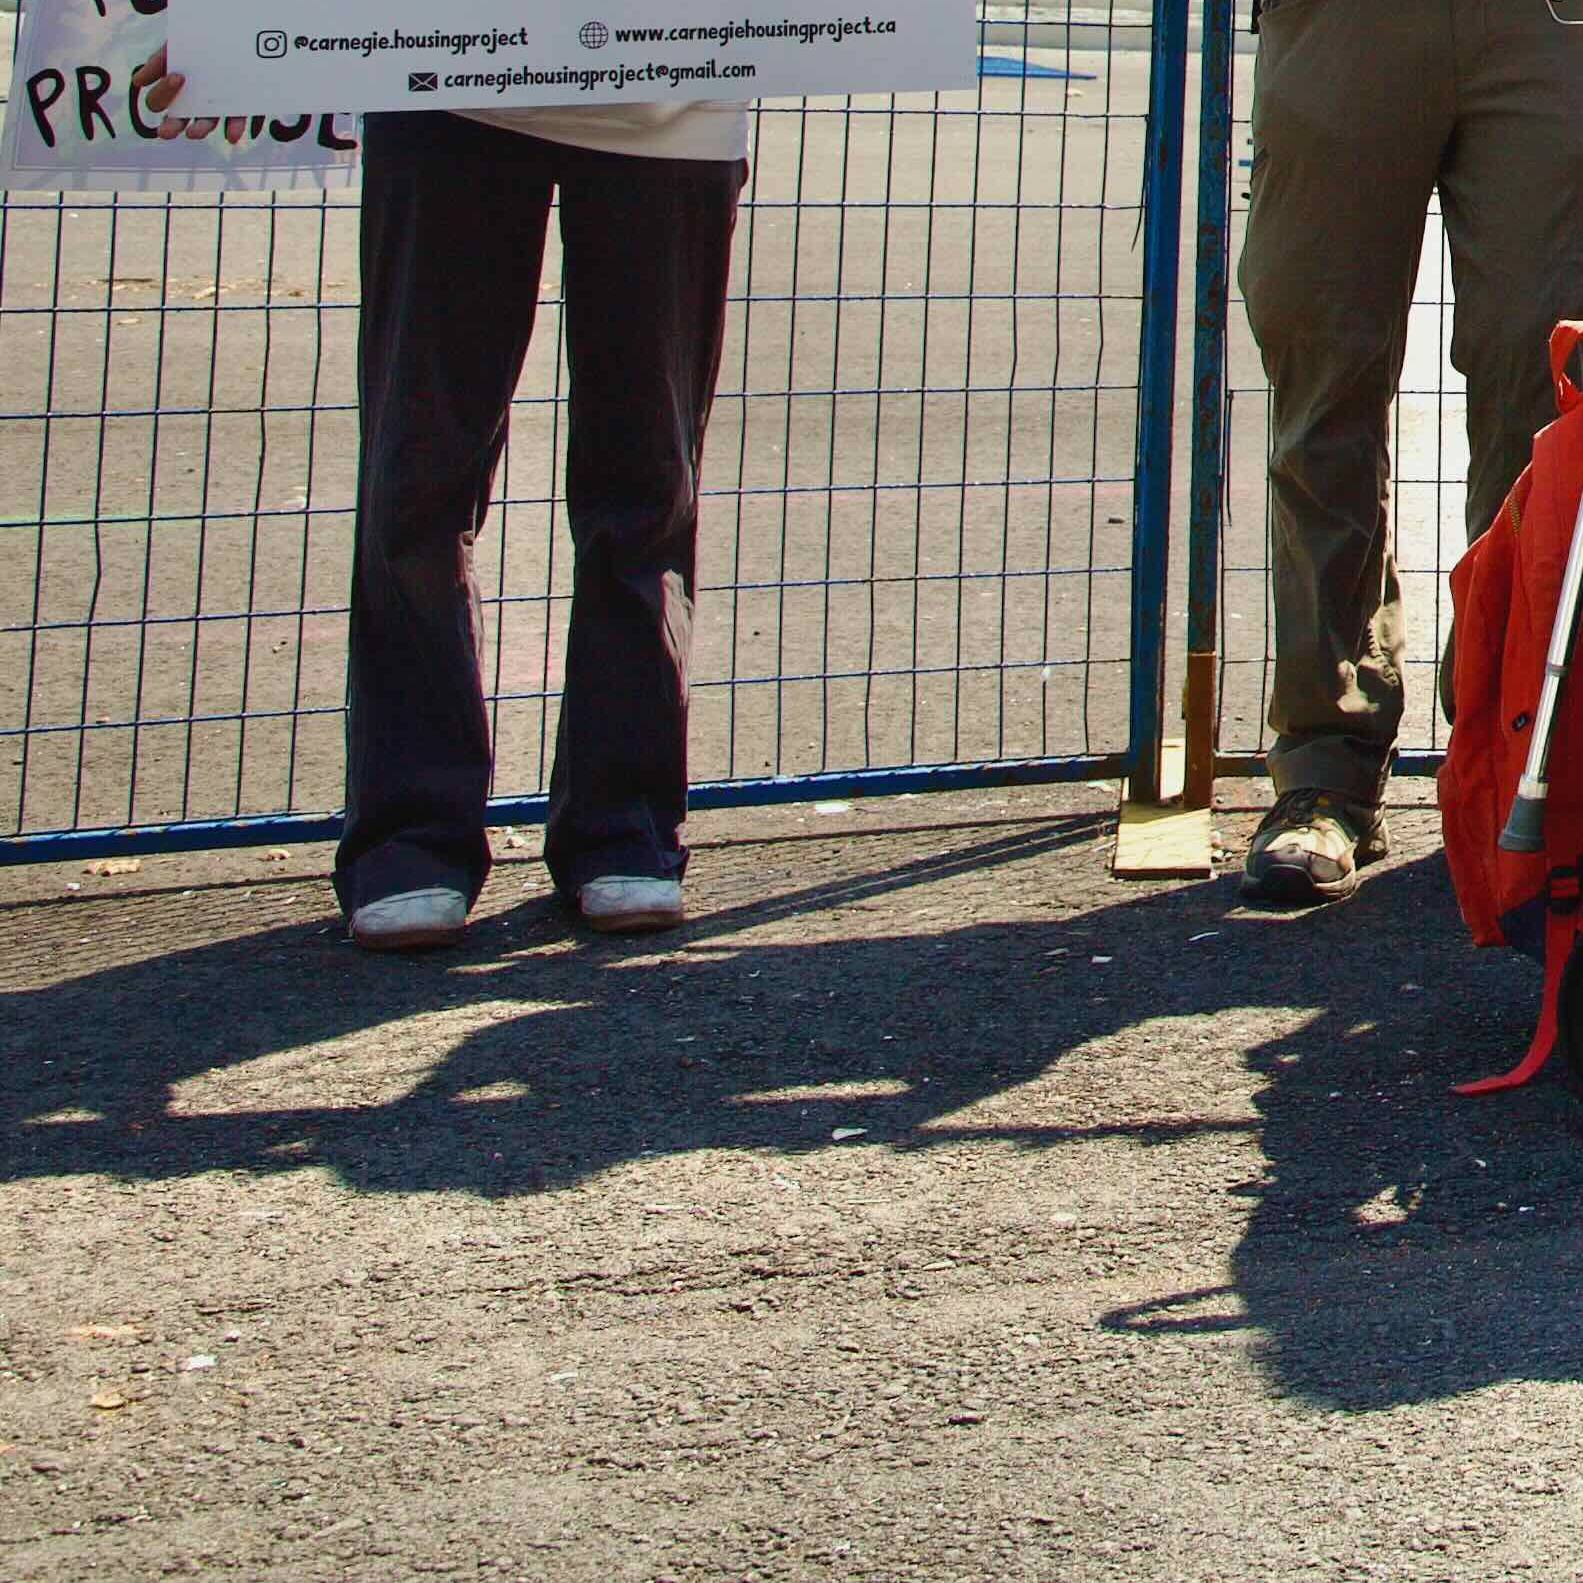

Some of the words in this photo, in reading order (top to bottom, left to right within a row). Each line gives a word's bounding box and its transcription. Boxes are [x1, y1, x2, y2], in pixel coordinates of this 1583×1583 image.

[294, 28, 529, 58] @carnegie.housingproject
[615, 17, 897, 49] www.carnegiehousingproject.ca
[443, 61, 757, 93] carnegiehousingproject@gmail.com
